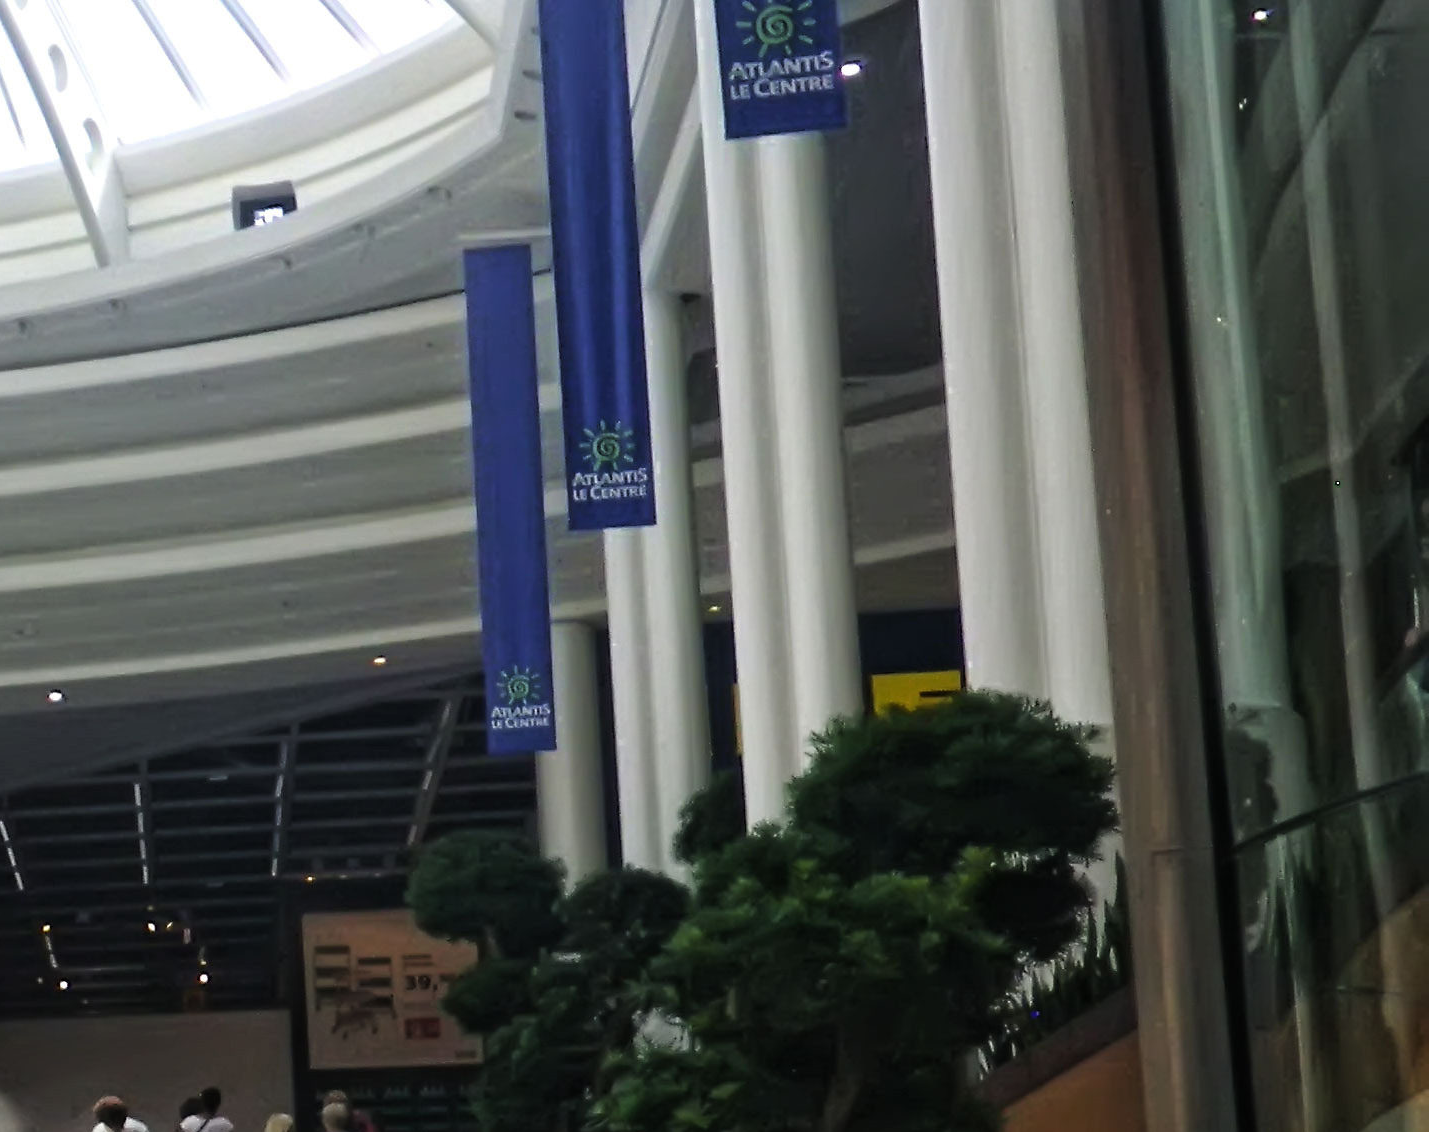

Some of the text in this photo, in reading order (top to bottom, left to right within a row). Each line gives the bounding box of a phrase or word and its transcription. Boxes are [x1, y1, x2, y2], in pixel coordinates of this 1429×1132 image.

[728, 50, 835, 80] ATLANTIS
[729, 74, 835, 100] LE CENTRE
[572, 467, 648, 487] ATLANTIS
[573, 484, 647, 501] LE CENTRE
